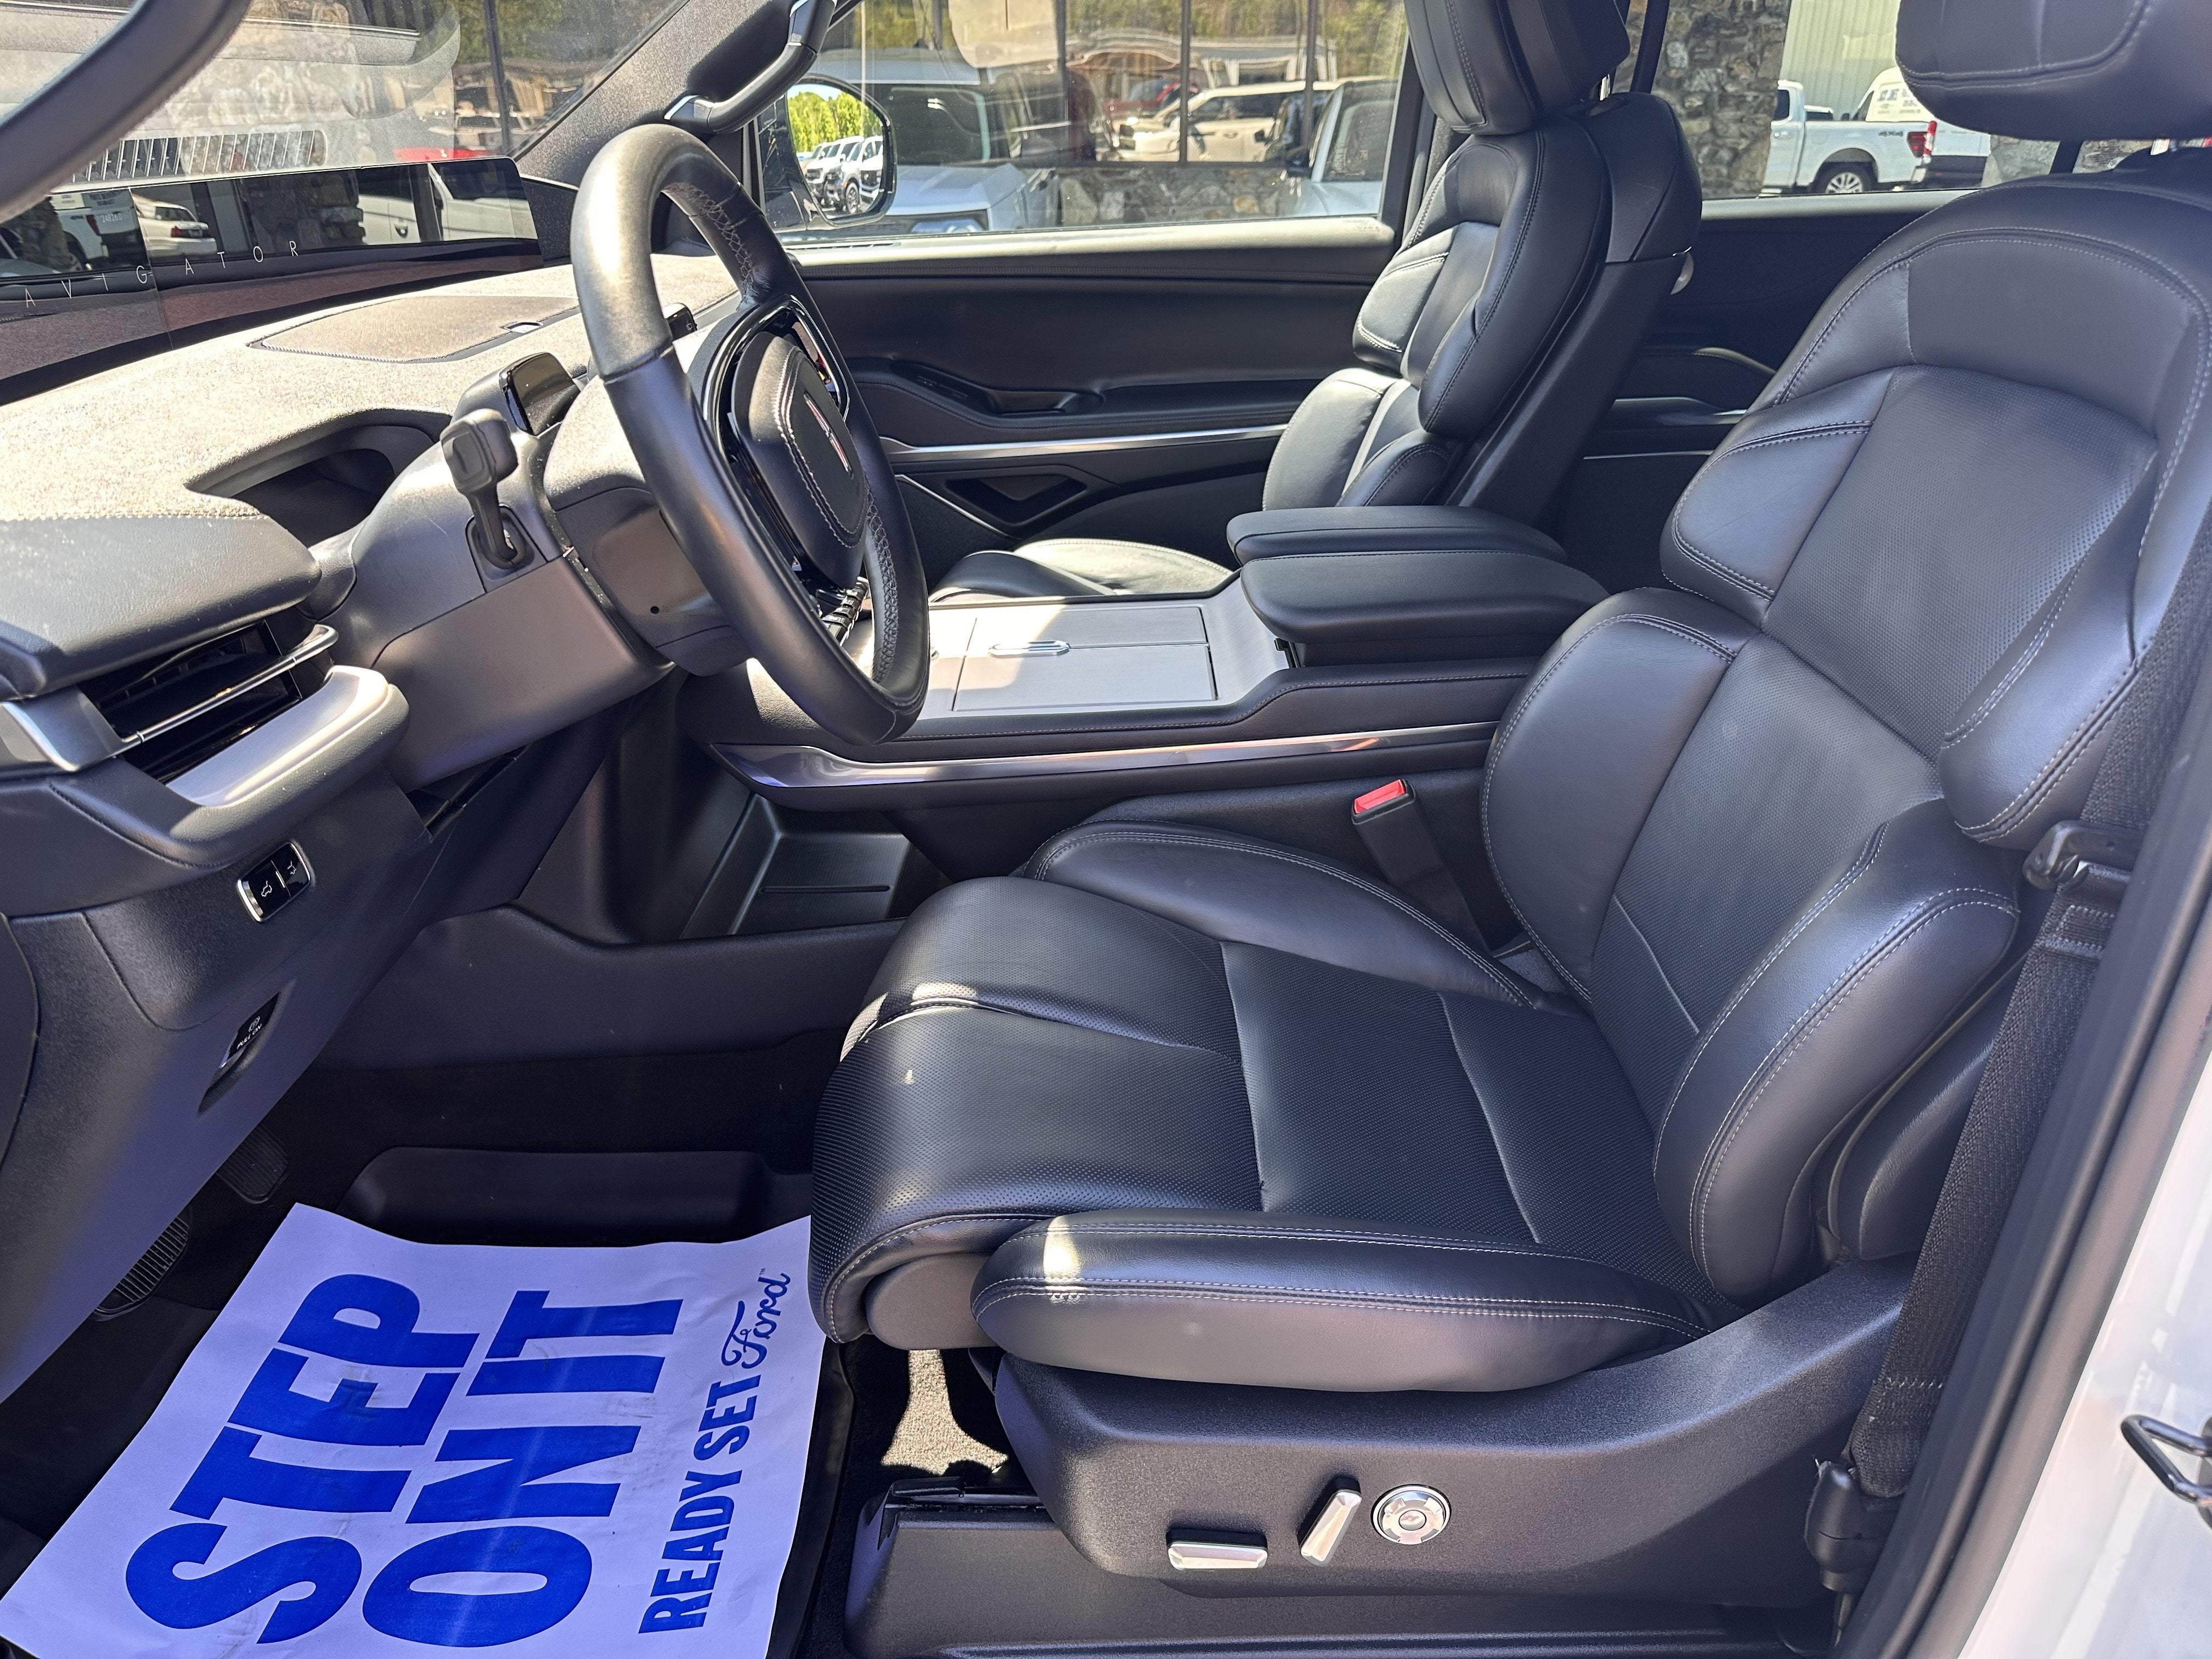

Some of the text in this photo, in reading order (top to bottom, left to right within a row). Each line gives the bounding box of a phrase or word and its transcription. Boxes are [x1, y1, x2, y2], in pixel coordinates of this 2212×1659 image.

[721, 1273, 791, 1369] Ford
[126, 1274, 479, 1644] STEP
[363, 1290, 684, 1647] ON IT
[693, 1374, 761, 1460] SET
[638, 1470, 743, 1634] READY
